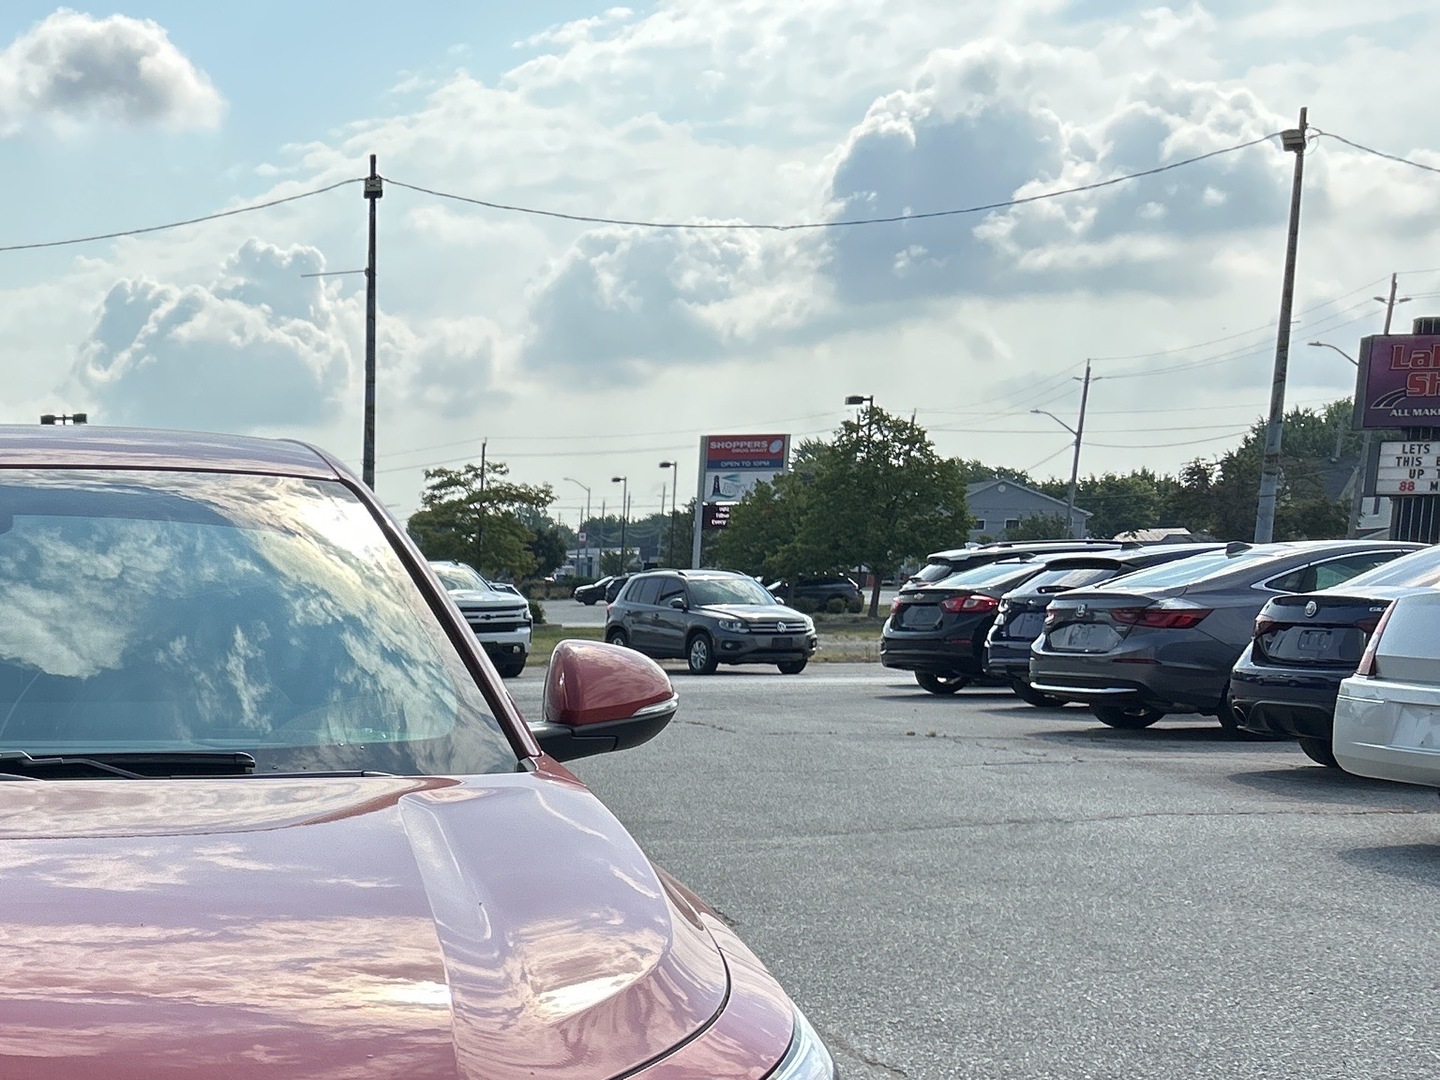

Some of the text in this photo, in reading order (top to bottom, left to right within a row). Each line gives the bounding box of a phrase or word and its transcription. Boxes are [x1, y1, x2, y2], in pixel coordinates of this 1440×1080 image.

[1389, 409, 1410, 417] ALL
[710, 440, 768, 449] SHOPPERS
[1402, 444, 1430, 454] LETS
[1396, 456, 1423, 467] THIS
[1408, 469, 1425, 479] UP
[1399, 481, 1415, 492] 88
